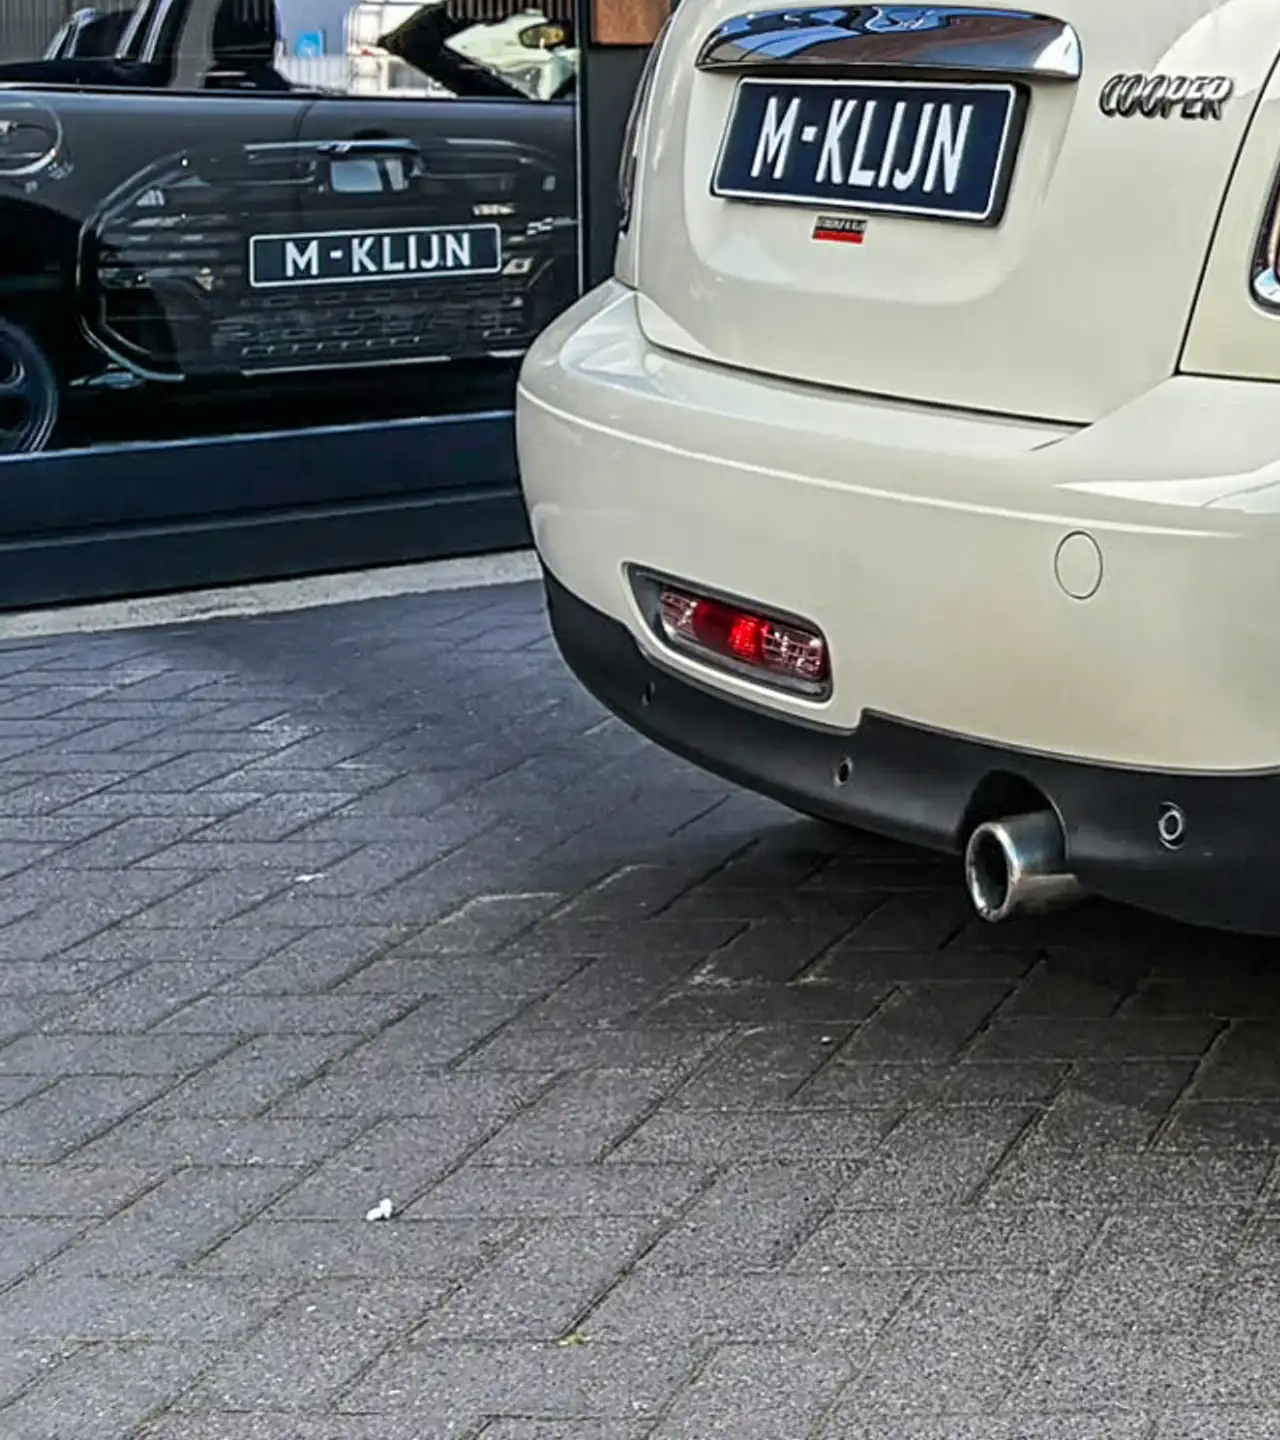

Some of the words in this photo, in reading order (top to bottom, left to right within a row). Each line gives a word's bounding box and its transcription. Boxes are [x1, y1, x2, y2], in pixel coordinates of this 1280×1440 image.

[1098, 73, 1235, 121] COOPER
[749, 96, 974, 194] M-KLIJN
[284, 231, 471, 278] M-KLIJN
